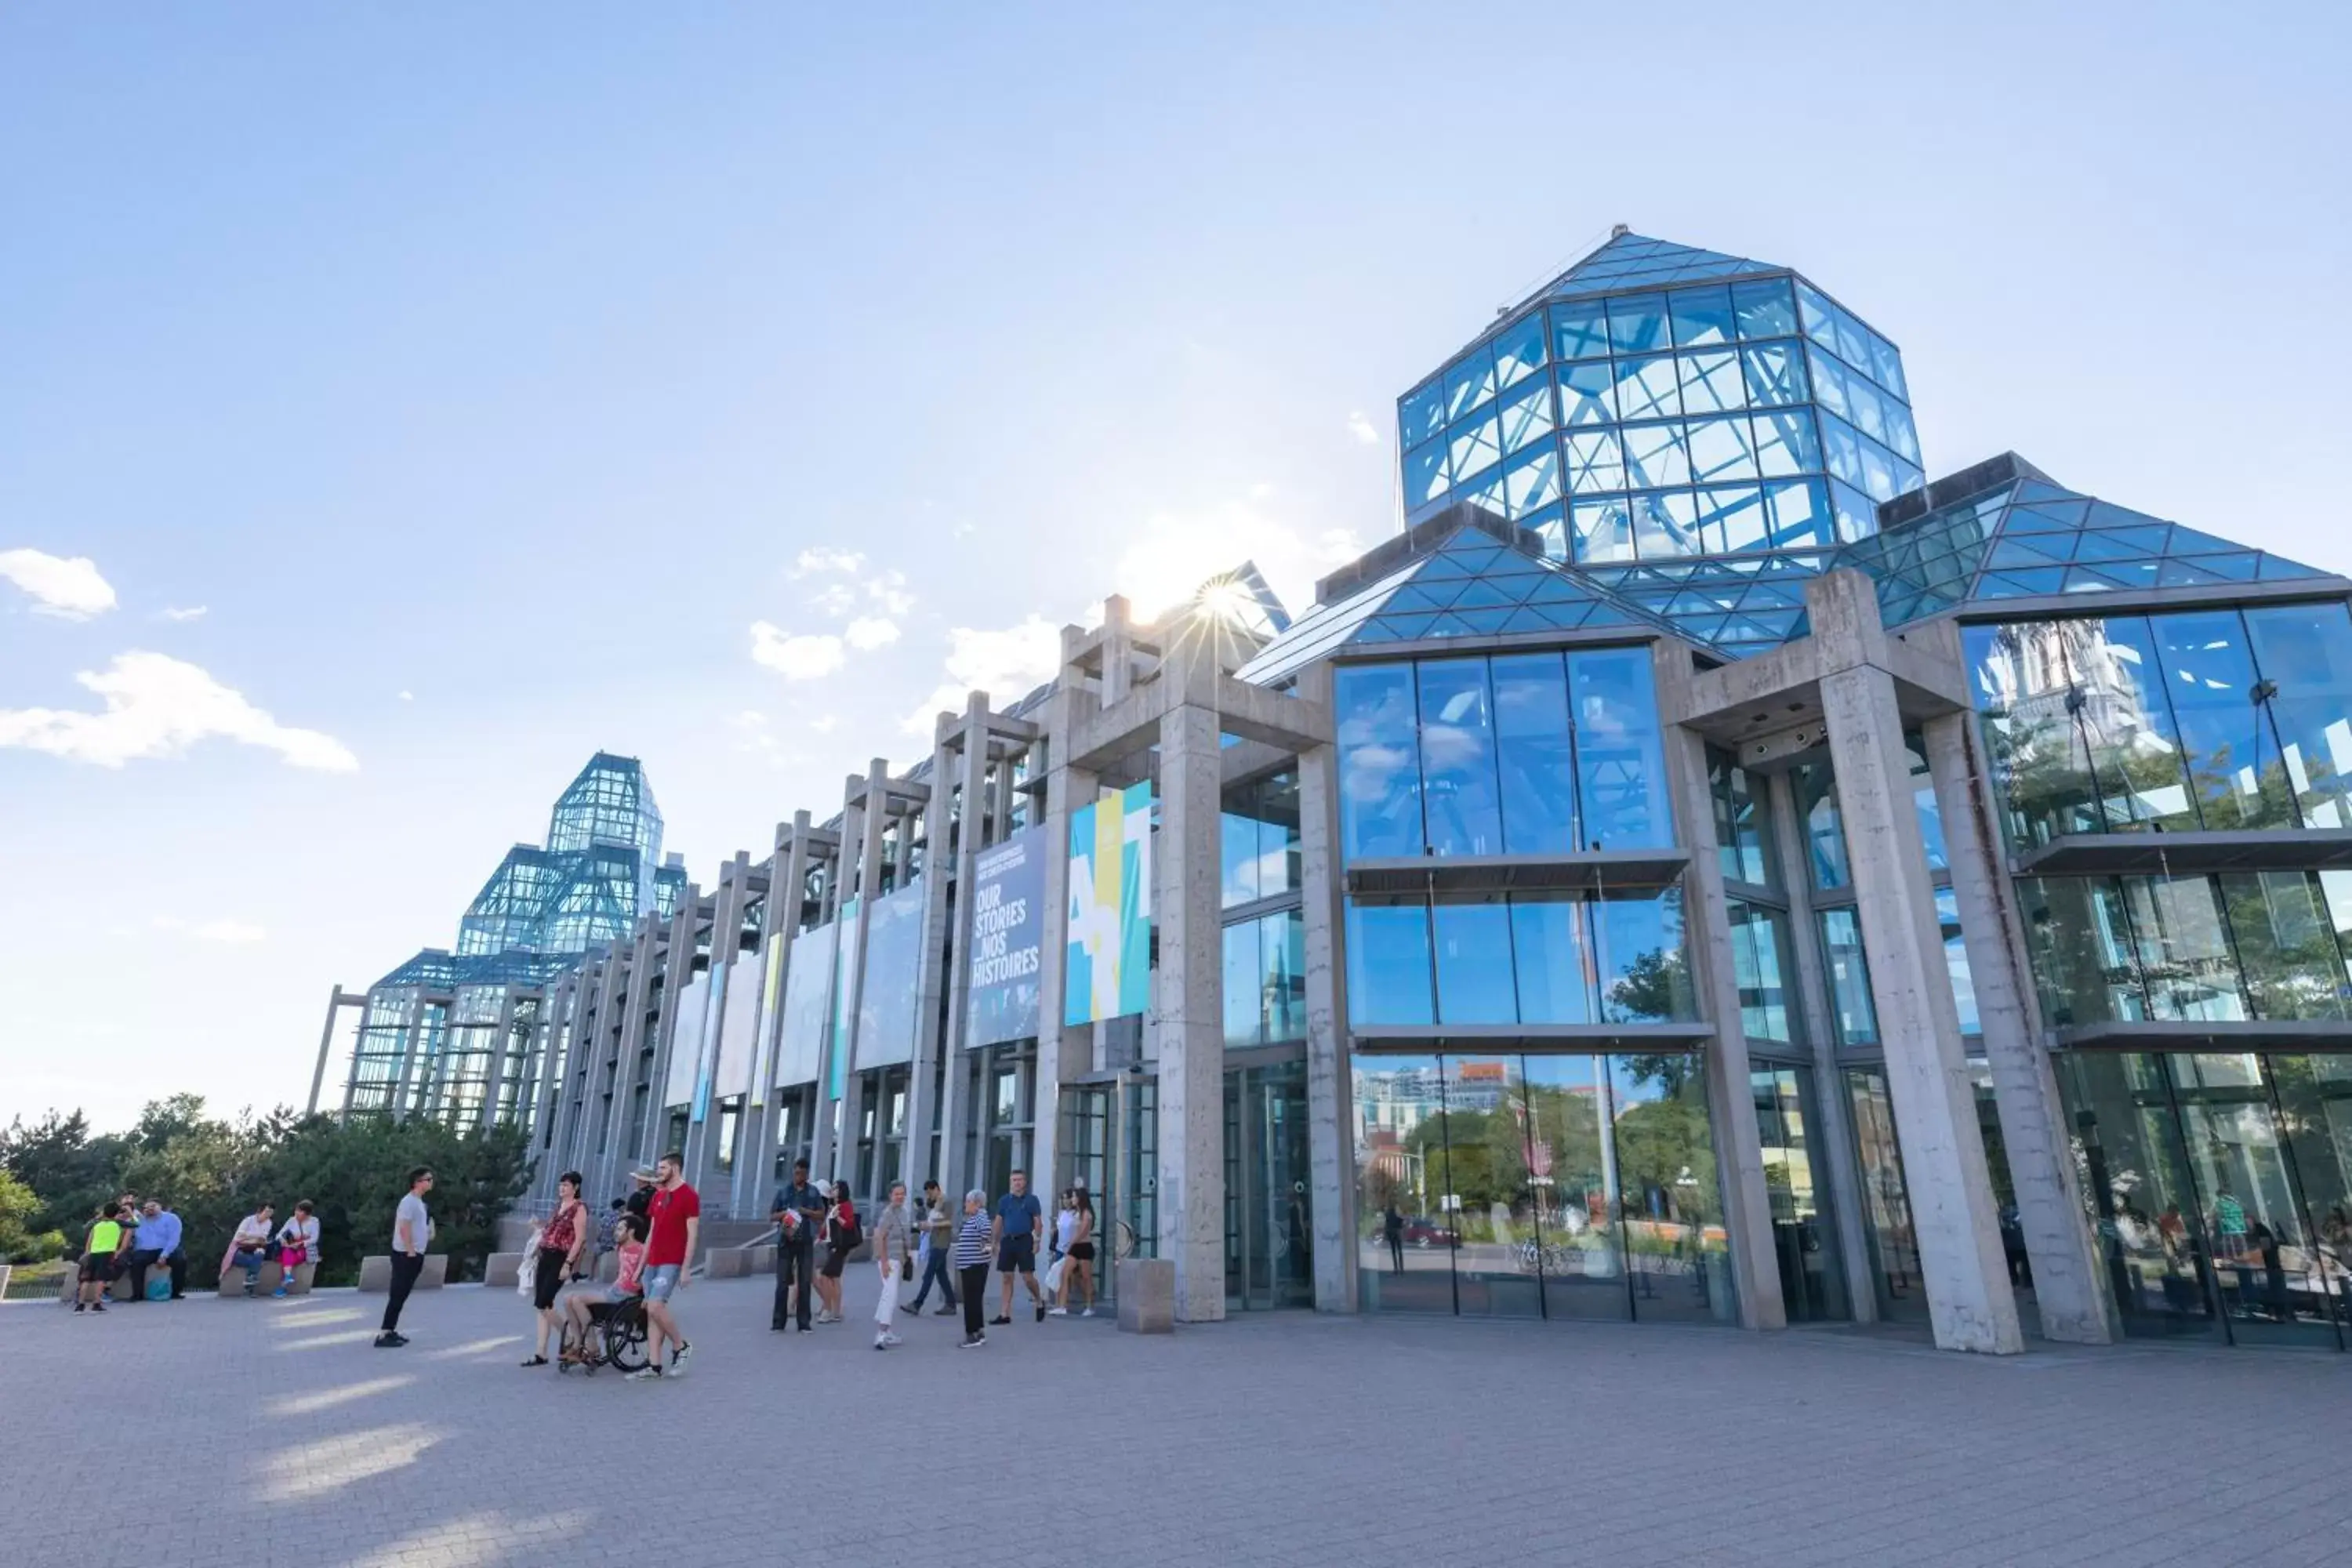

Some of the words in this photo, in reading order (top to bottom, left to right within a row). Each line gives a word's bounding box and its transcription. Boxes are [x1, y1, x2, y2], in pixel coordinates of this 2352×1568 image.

[975, 898, 1026, 938] STORIES
[977, 884, 1001, 913] OUR
[972, 946, 1039, 989] HISTOIRES
